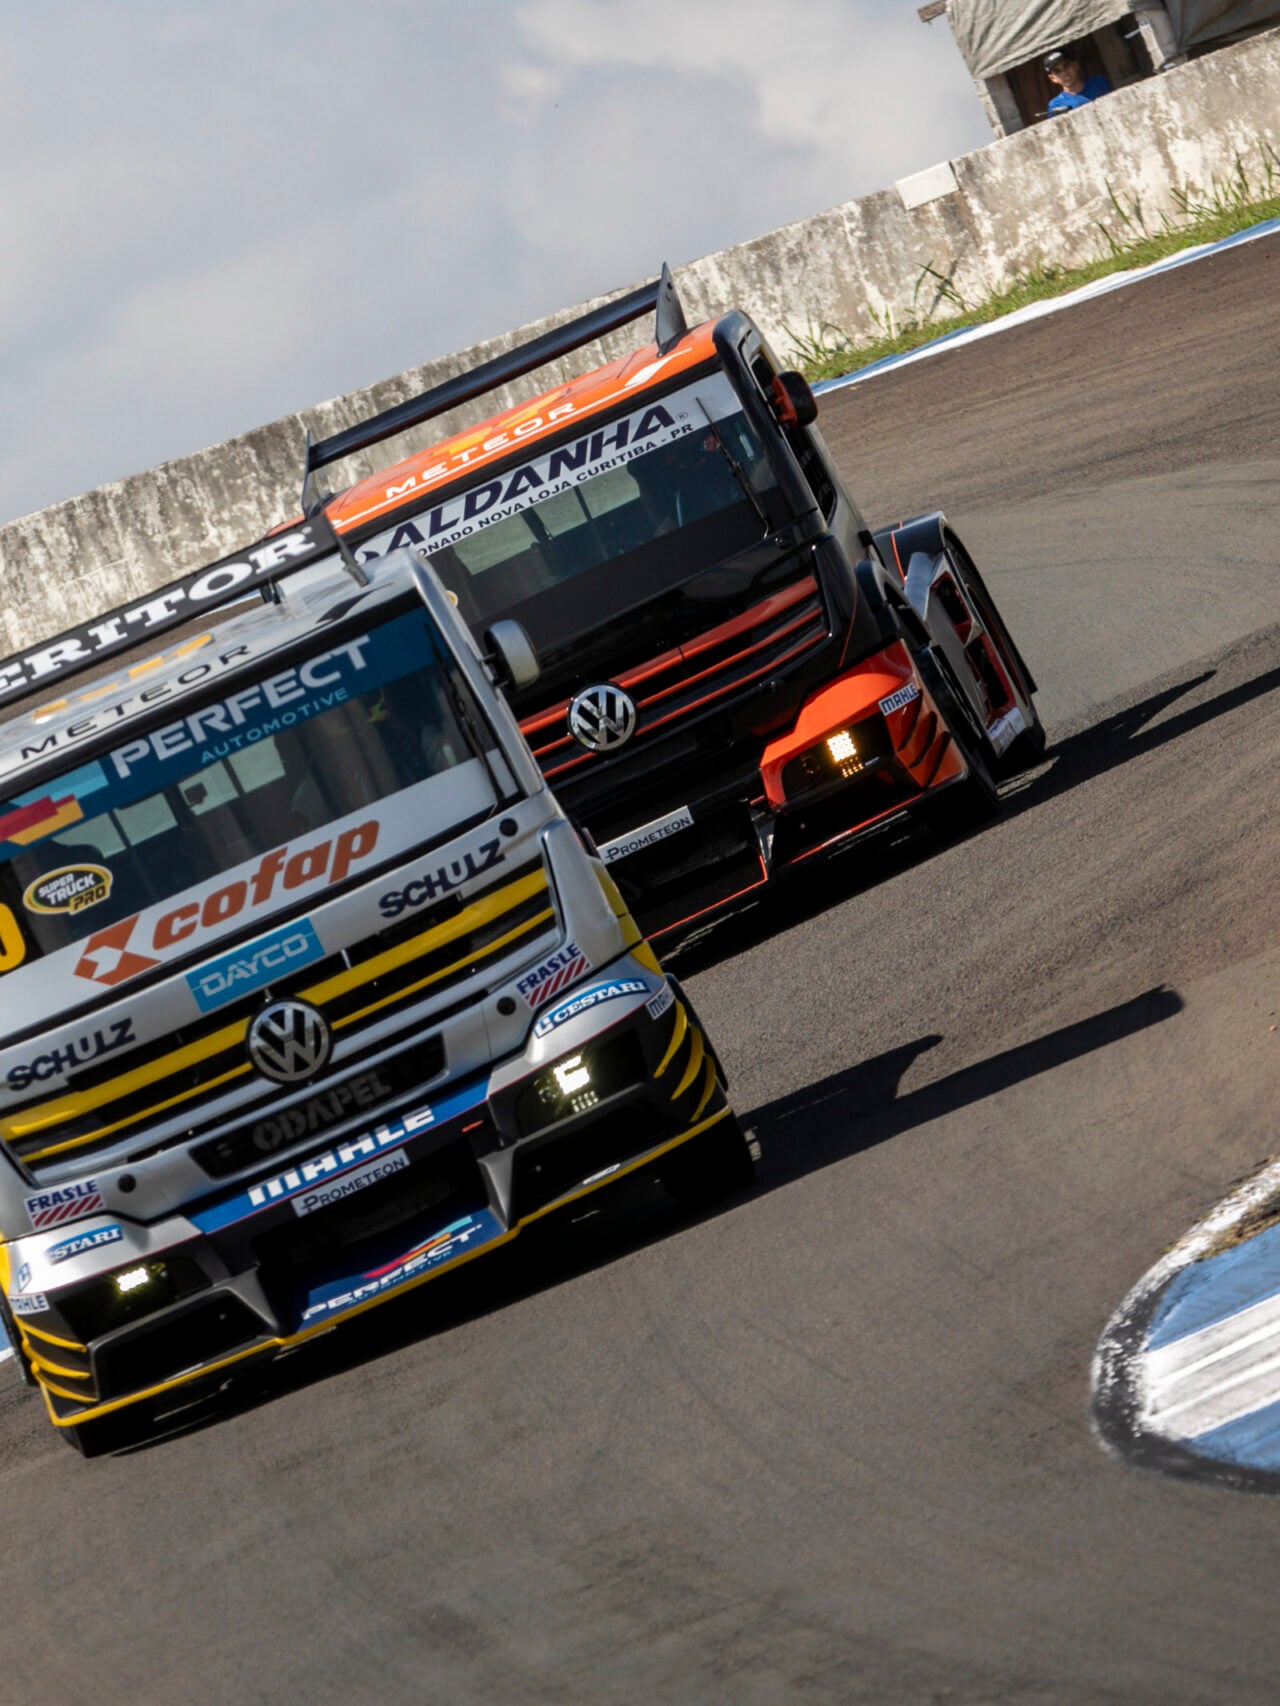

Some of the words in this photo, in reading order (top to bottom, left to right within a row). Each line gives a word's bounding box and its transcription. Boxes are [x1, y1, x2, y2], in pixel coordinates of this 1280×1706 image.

[385, 403, 576, 499] METEOR
[478, 502, 524, 528] NOVA
[529, 480, 573, 504] LOJA
[576, 441, 657, 482] CURITIBA
[670, 423, 694, 440] PR
[21, 644, 251, 760] METEOR
[110, 634, 370, 779] PERFECT
[200, 687, 350, 764] AUTOMOTIVE
[879, 684, 920, 715] MAHLE
[605, 816, 691, 861] PROMETEON
[38, 873, 74, 897] SUPER
[47, 873, 95, 905] TRUCK
[73, 885, 106, 910] PRO
[151, 819, 380, 951] cofap
[378, 837, 506, 918] SCHULZ
[199, 933, 309, 998] DAYCO
[554, 981, 647, 1023] CESTARI
[7, 1017, 137, 1091] SCHULZ
[247, 1104, 435, 1207] MAHLE
[300, 1157, 405, 1212] PROMETEON
[301, 1226, 477, 1321] PERFECT
